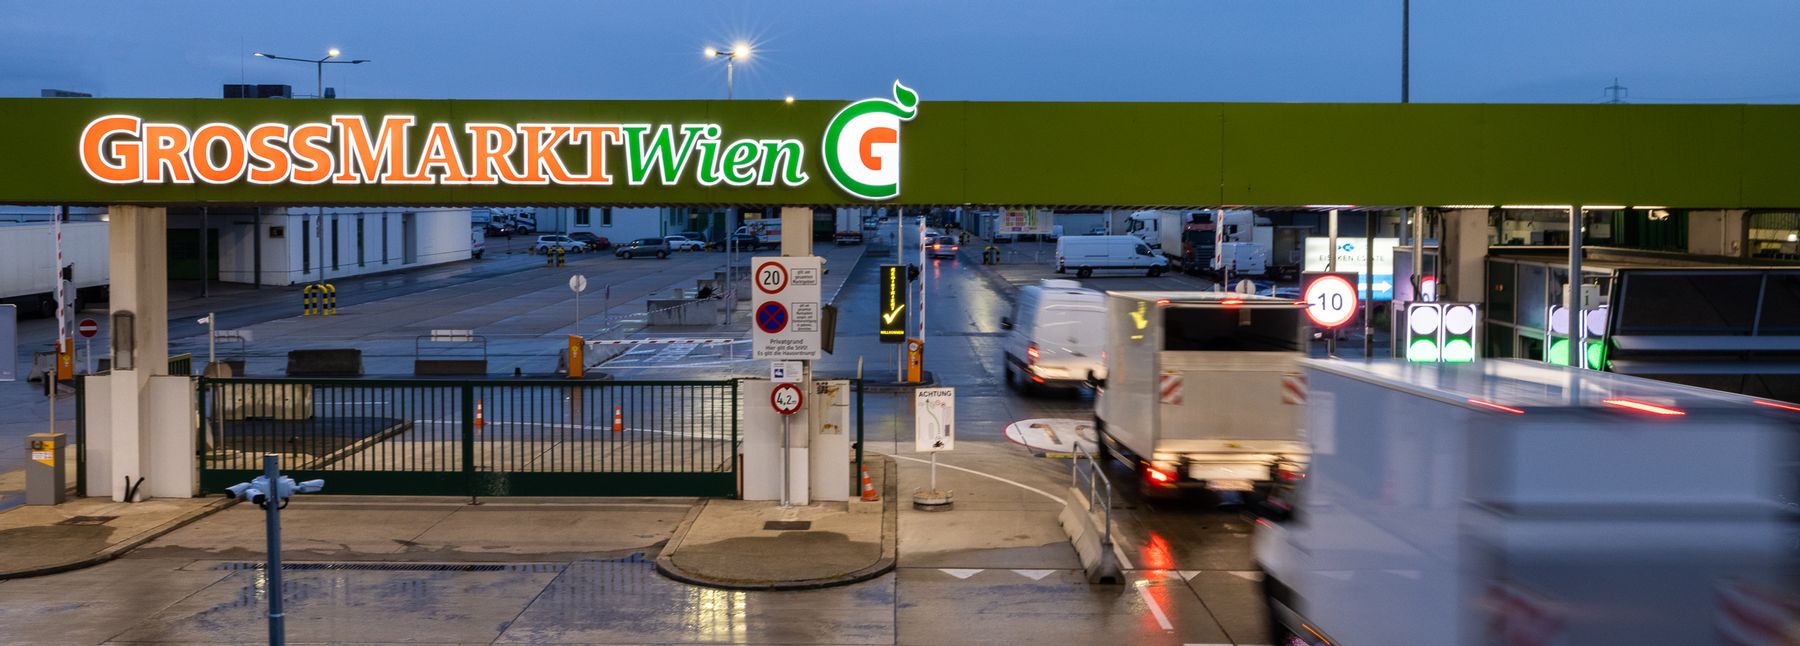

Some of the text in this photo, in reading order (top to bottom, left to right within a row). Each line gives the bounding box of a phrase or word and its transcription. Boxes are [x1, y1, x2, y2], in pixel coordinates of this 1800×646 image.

[763, 270, 780, 286] 20
[1317, 292, 1343, 311] 10
[769, 338, 804, 346] Privatgrund
[918, 390, 952, 398] ACHTUNG
